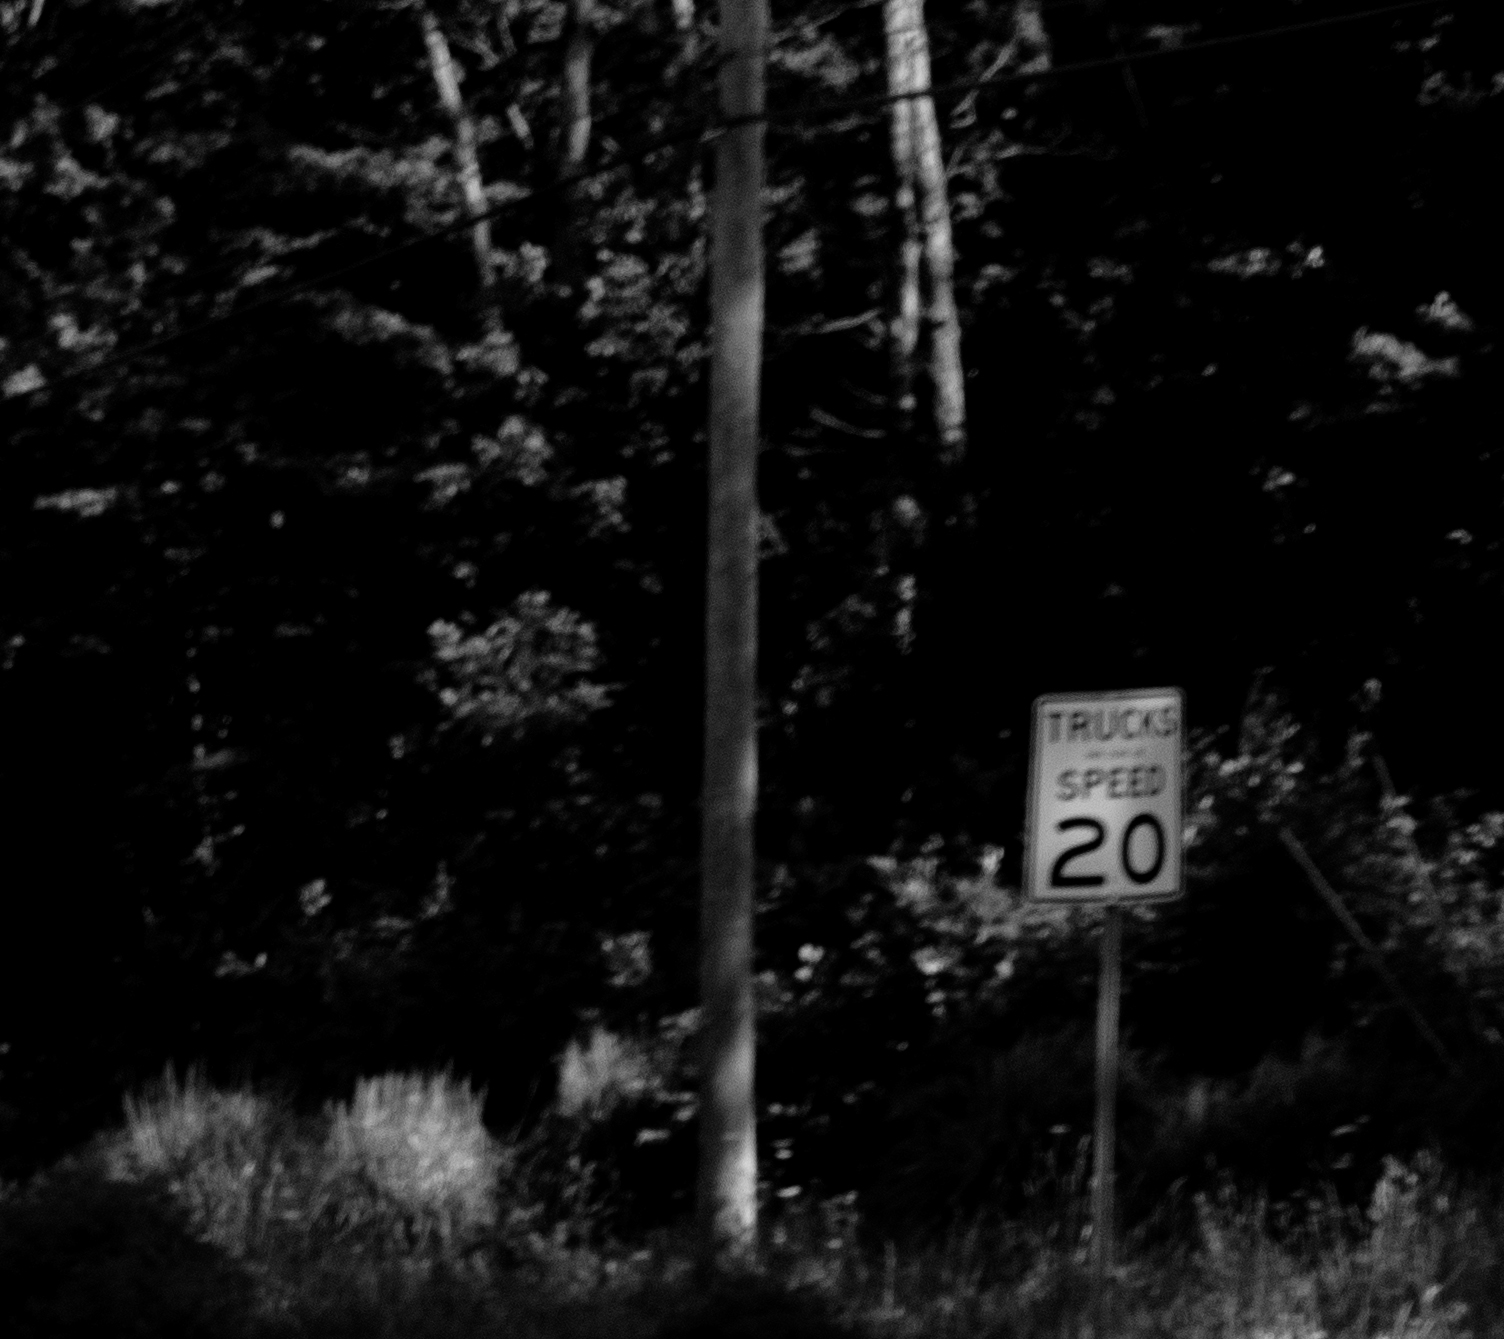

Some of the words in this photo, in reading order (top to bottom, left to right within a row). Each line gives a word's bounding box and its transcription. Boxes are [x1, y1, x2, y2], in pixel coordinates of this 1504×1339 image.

[1044, 706, 1179, 742] TRUCKS
[1056, 763, 1168, 801] SPEED
[1048, 812, 1167, 890] 20
